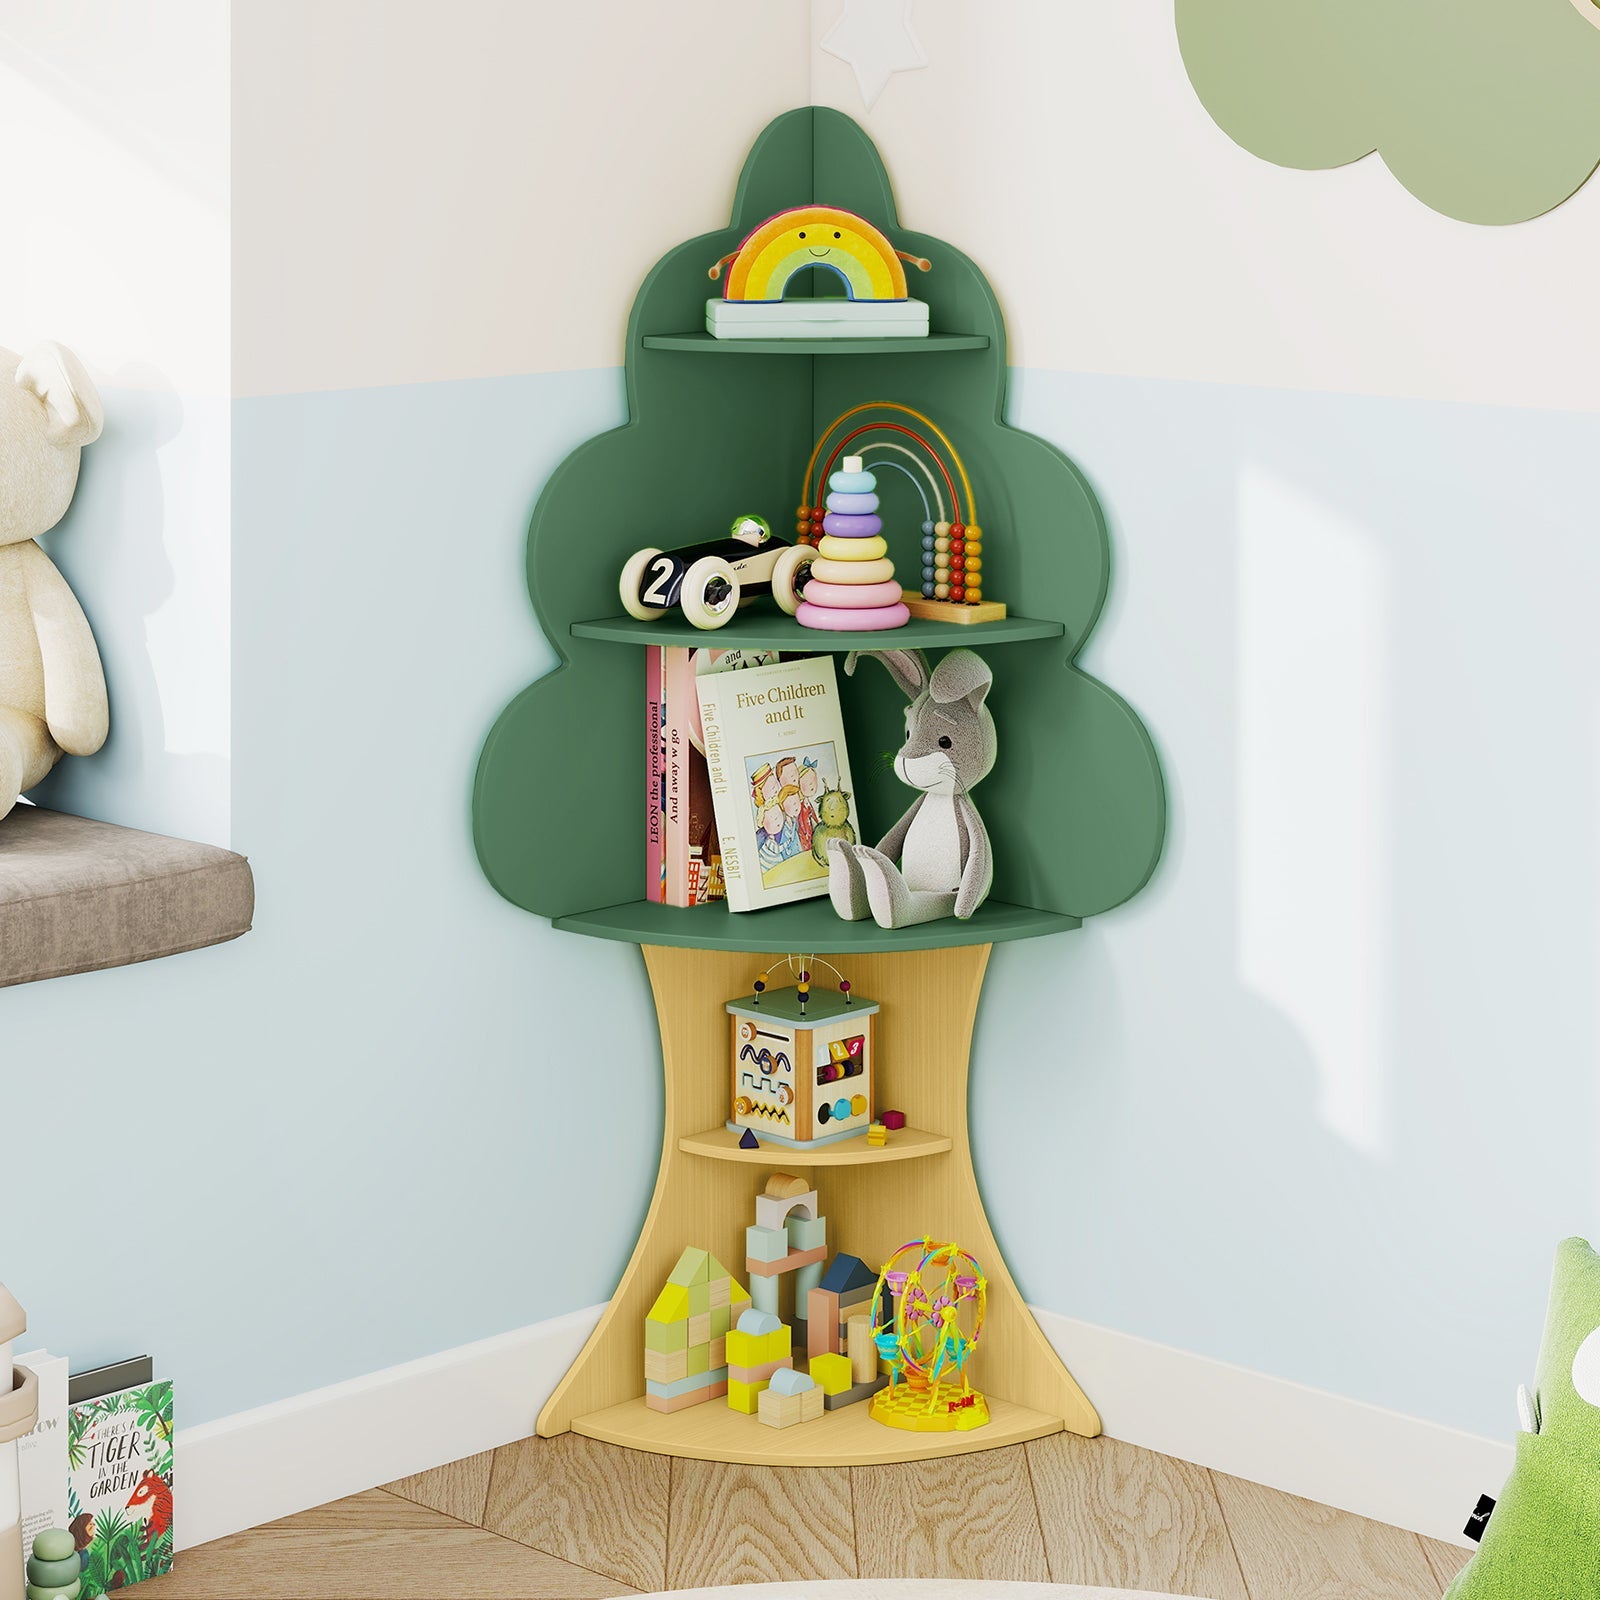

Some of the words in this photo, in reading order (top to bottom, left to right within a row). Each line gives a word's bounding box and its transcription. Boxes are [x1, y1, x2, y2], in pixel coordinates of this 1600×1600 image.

[643, 557, 675, 605] 2
[736, 692, 765, 709] Five
[767, 683, 826, 704] Children
[702, 703, 716, 722] Five
[765, 705, 791, 724] and
[794, 704, 805, 719] It
[649, 701, 661, 778] professional
[671, 728, 680, 744] go
[705, 725, 723, 765] Children
[672, 748, 678, 758] w
[671, 763, 681, 793] away
[712, 767, 726, 784] and
[650, 780, 659, 800] the
[715, 786, 727, 794] It
[670, 797, 678, 824] And
[650, 804, 659, 844] LEON
[722, 836, 735, 845] E.
[723, 848, 741, 879] NESBIT
[833, 1043, 844, 1057] 2
[850, 1041, 860, 1055] 3
[88, 1431, 140, 1468] TIGER
[98, 1466, 107, 1479] IN
[112, 1460, 128, 1475] THE
[90, 1470, 139, 1498] GARDEN
